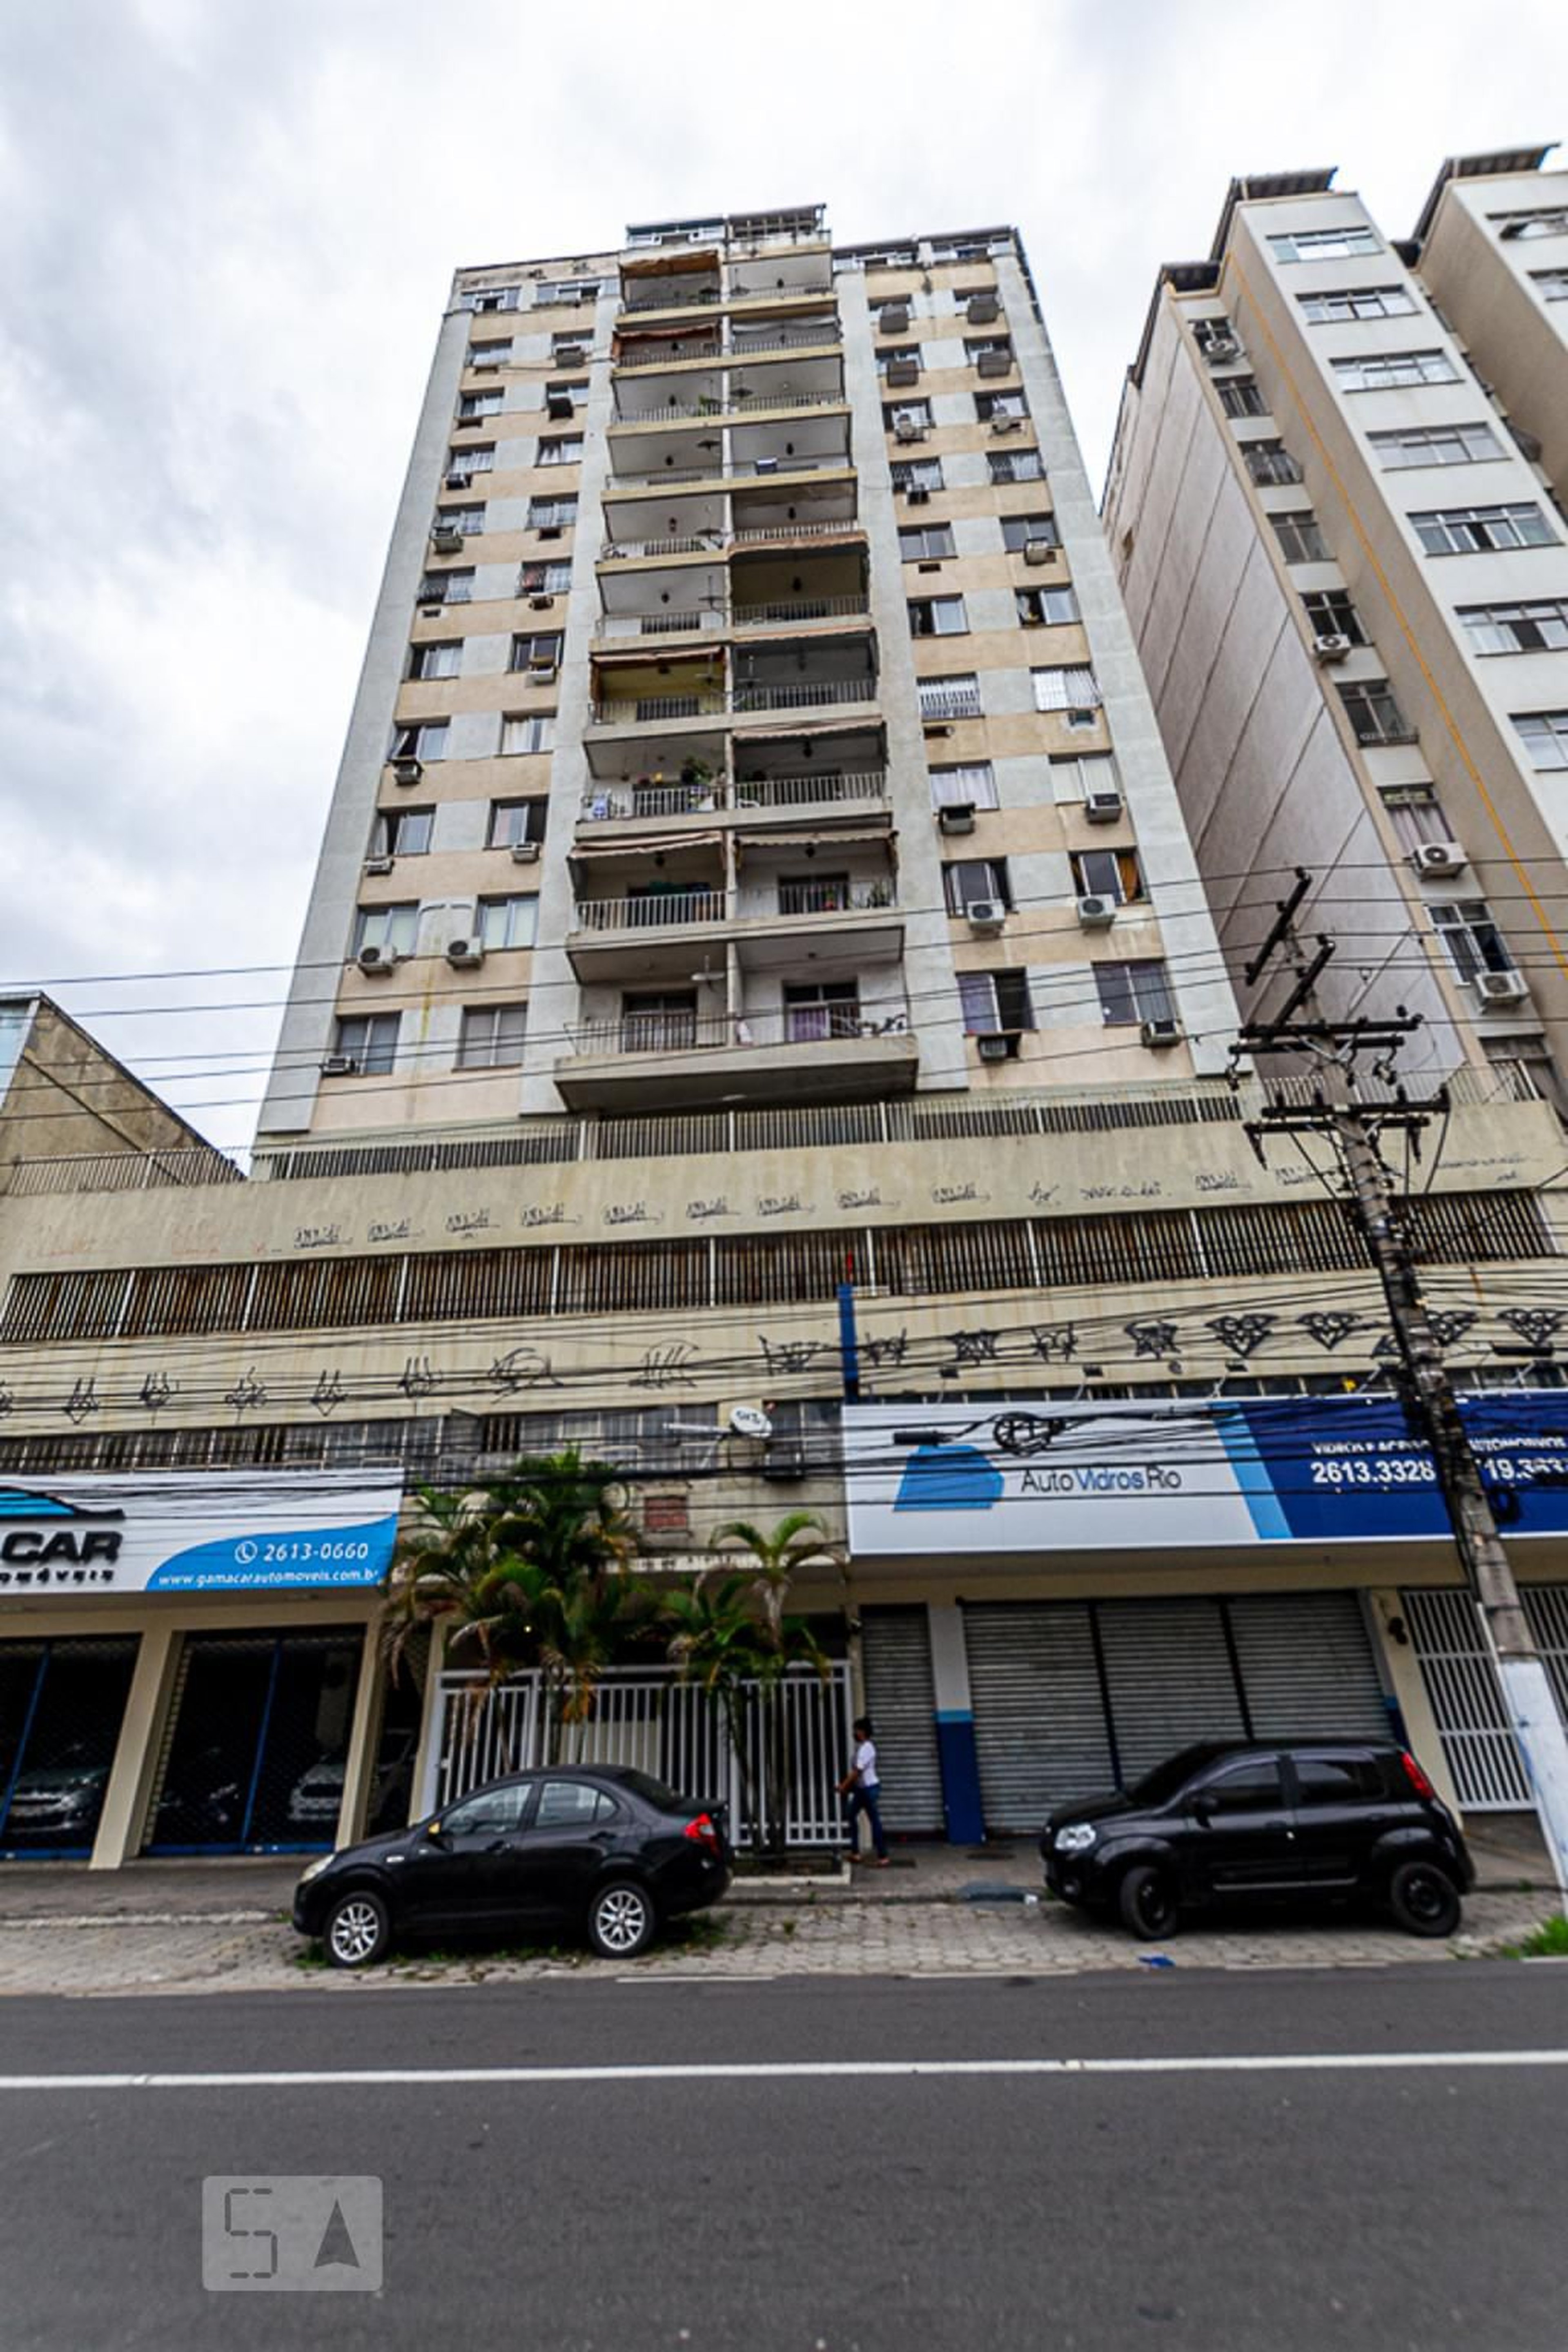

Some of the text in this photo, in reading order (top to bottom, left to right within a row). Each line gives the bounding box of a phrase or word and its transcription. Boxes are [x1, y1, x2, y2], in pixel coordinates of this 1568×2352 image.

[1310, 1461, 1437, 1483] 2613.3328
[2, 1531, 123, 1564] CAR
[264, 1543, 368, 1561] 2613-0660
[158, 1568, 378, 1588] www.gamacarautomoveis.com.br
